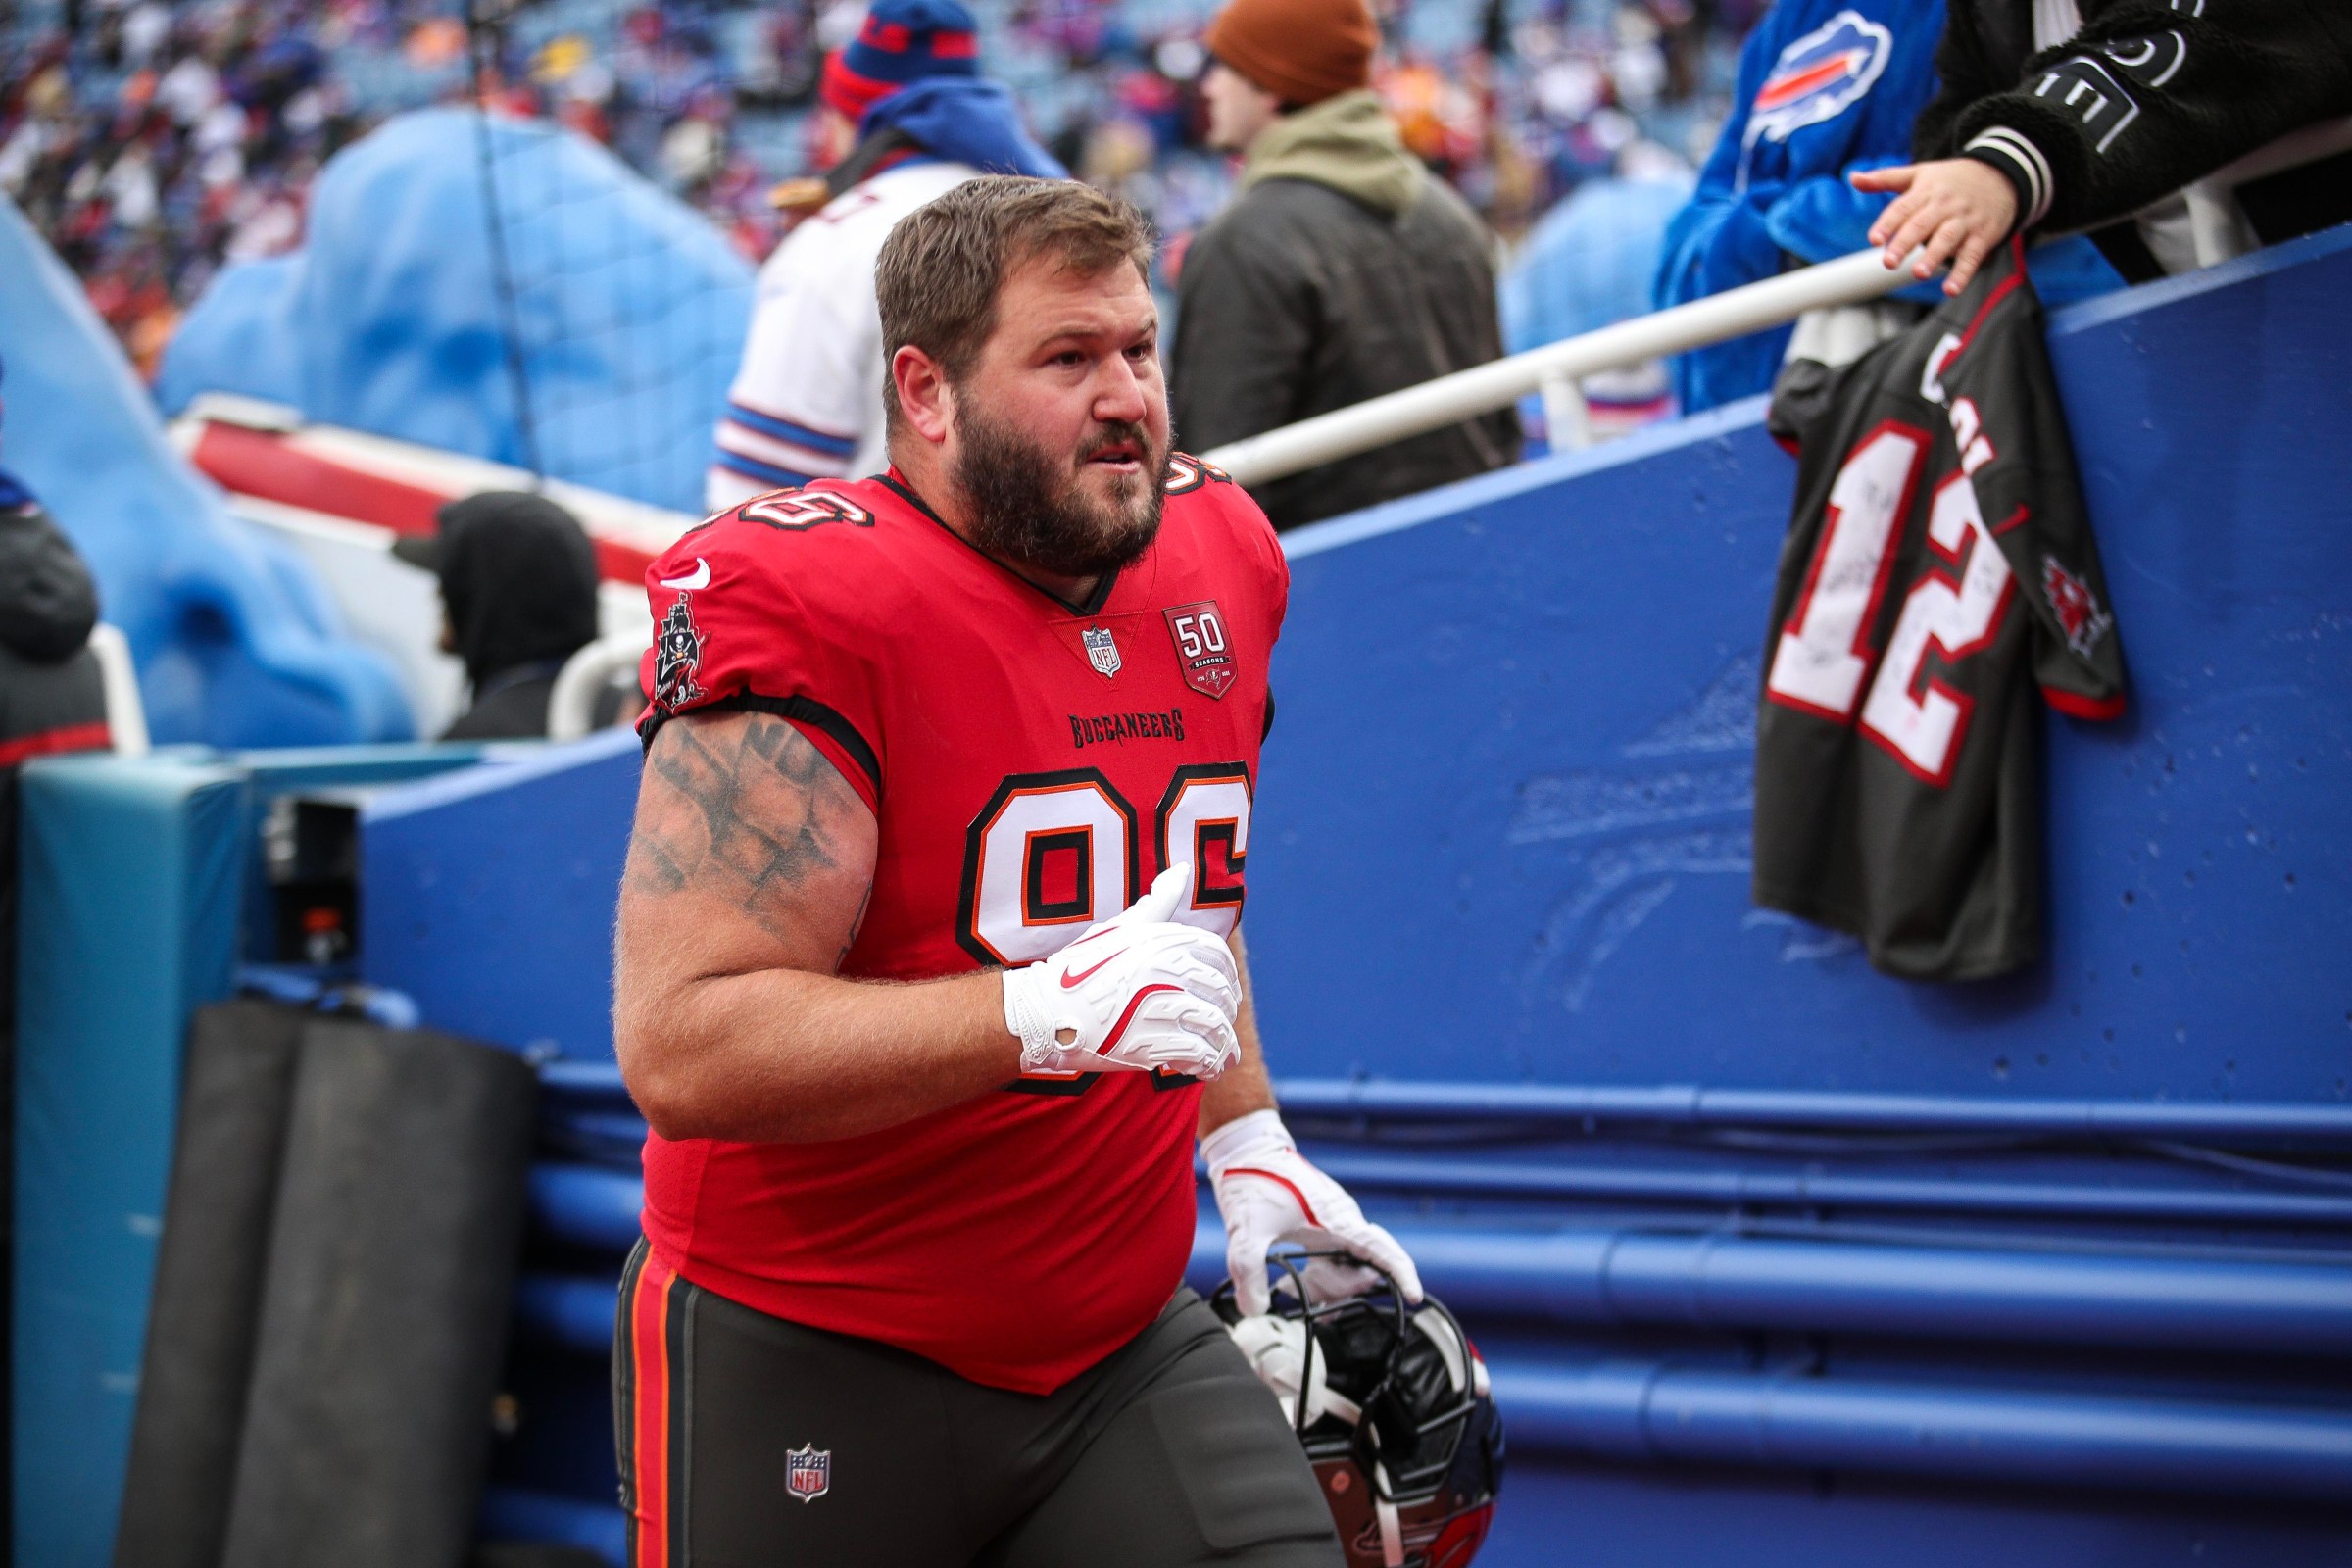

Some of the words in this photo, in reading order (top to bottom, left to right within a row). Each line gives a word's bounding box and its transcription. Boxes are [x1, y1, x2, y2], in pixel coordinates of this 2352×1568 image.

[1767, 418, 2016, 790] 12
[1173, 612, 1226, 659] 50
[1093, 647, 1116, 668] NFL
[1195, 657, 1225, 668] SEASONS
[1068, 708, 1185, 748] BUCCANEERS
[794, 1471, 823, 1491] NFL
